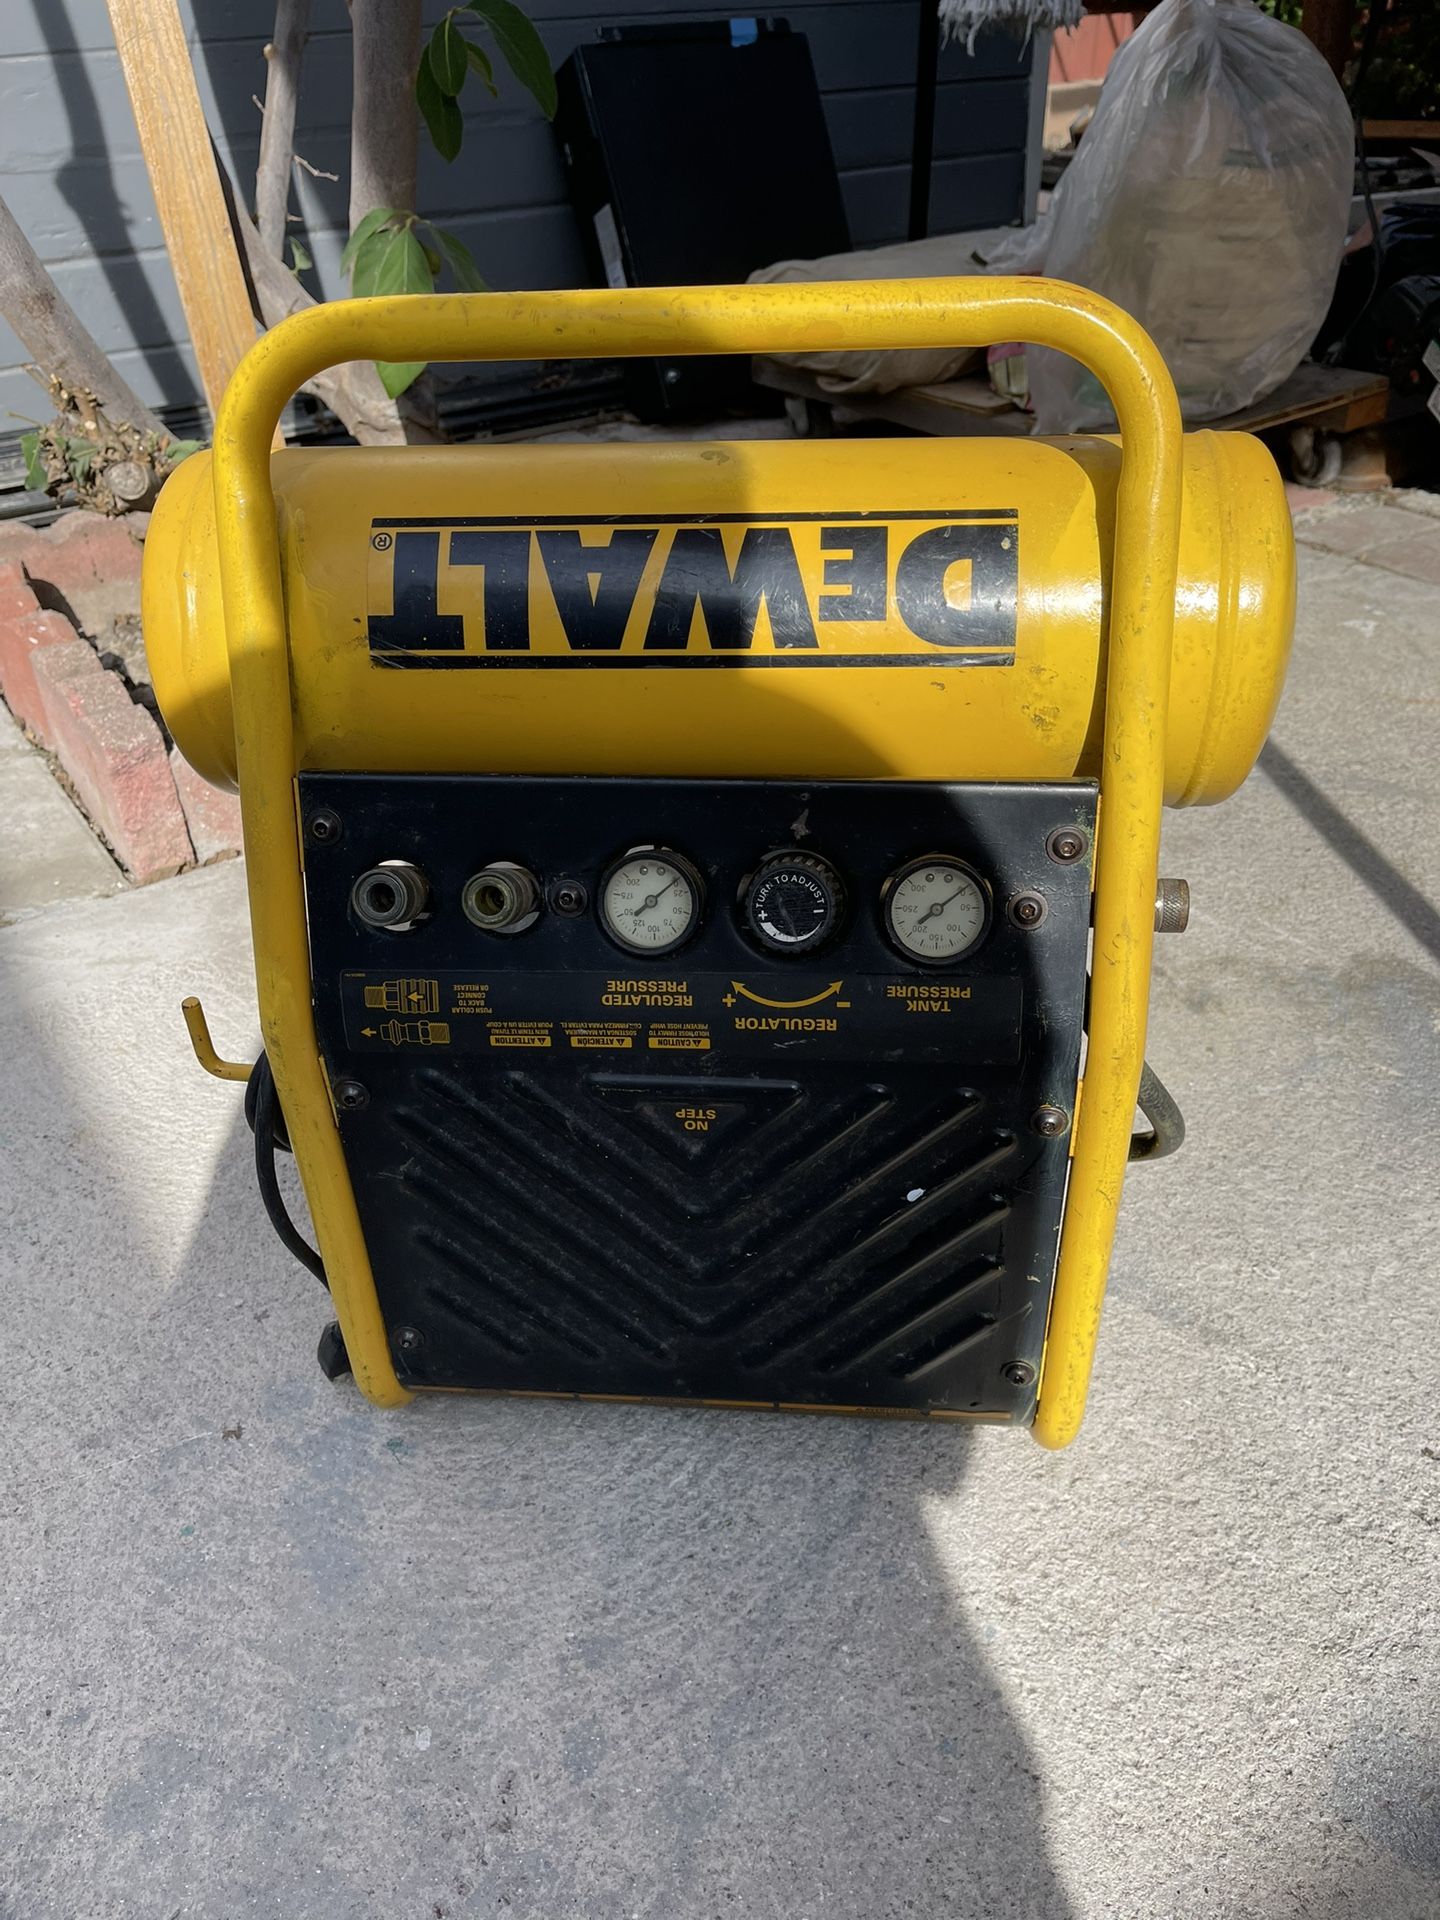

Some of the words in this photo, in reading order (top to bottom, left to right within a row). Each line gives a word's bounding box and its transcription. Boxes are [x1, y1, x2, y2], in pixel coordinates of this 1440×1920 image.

[367, 525, 1018, 651] DEWALT
[756, 881, 773, 908] TURN
[774, 874, 789, 884] TO
[790, 875, 824, 904] ADJUST
[606, 980, 687, 992] PRESSURE
[886, 985, 971, 998] PRESSURE
[601, 994, 693, 1006] REGULATED
[906, 1000, 951, 1012] TANK
[734, 1017, 837, 1031] REGULATOR
[658, 1039, 690, 1047] CAUTION
[675, 1109, 716, 1120] STEP
[684, 1120, 708, 1130] NO
